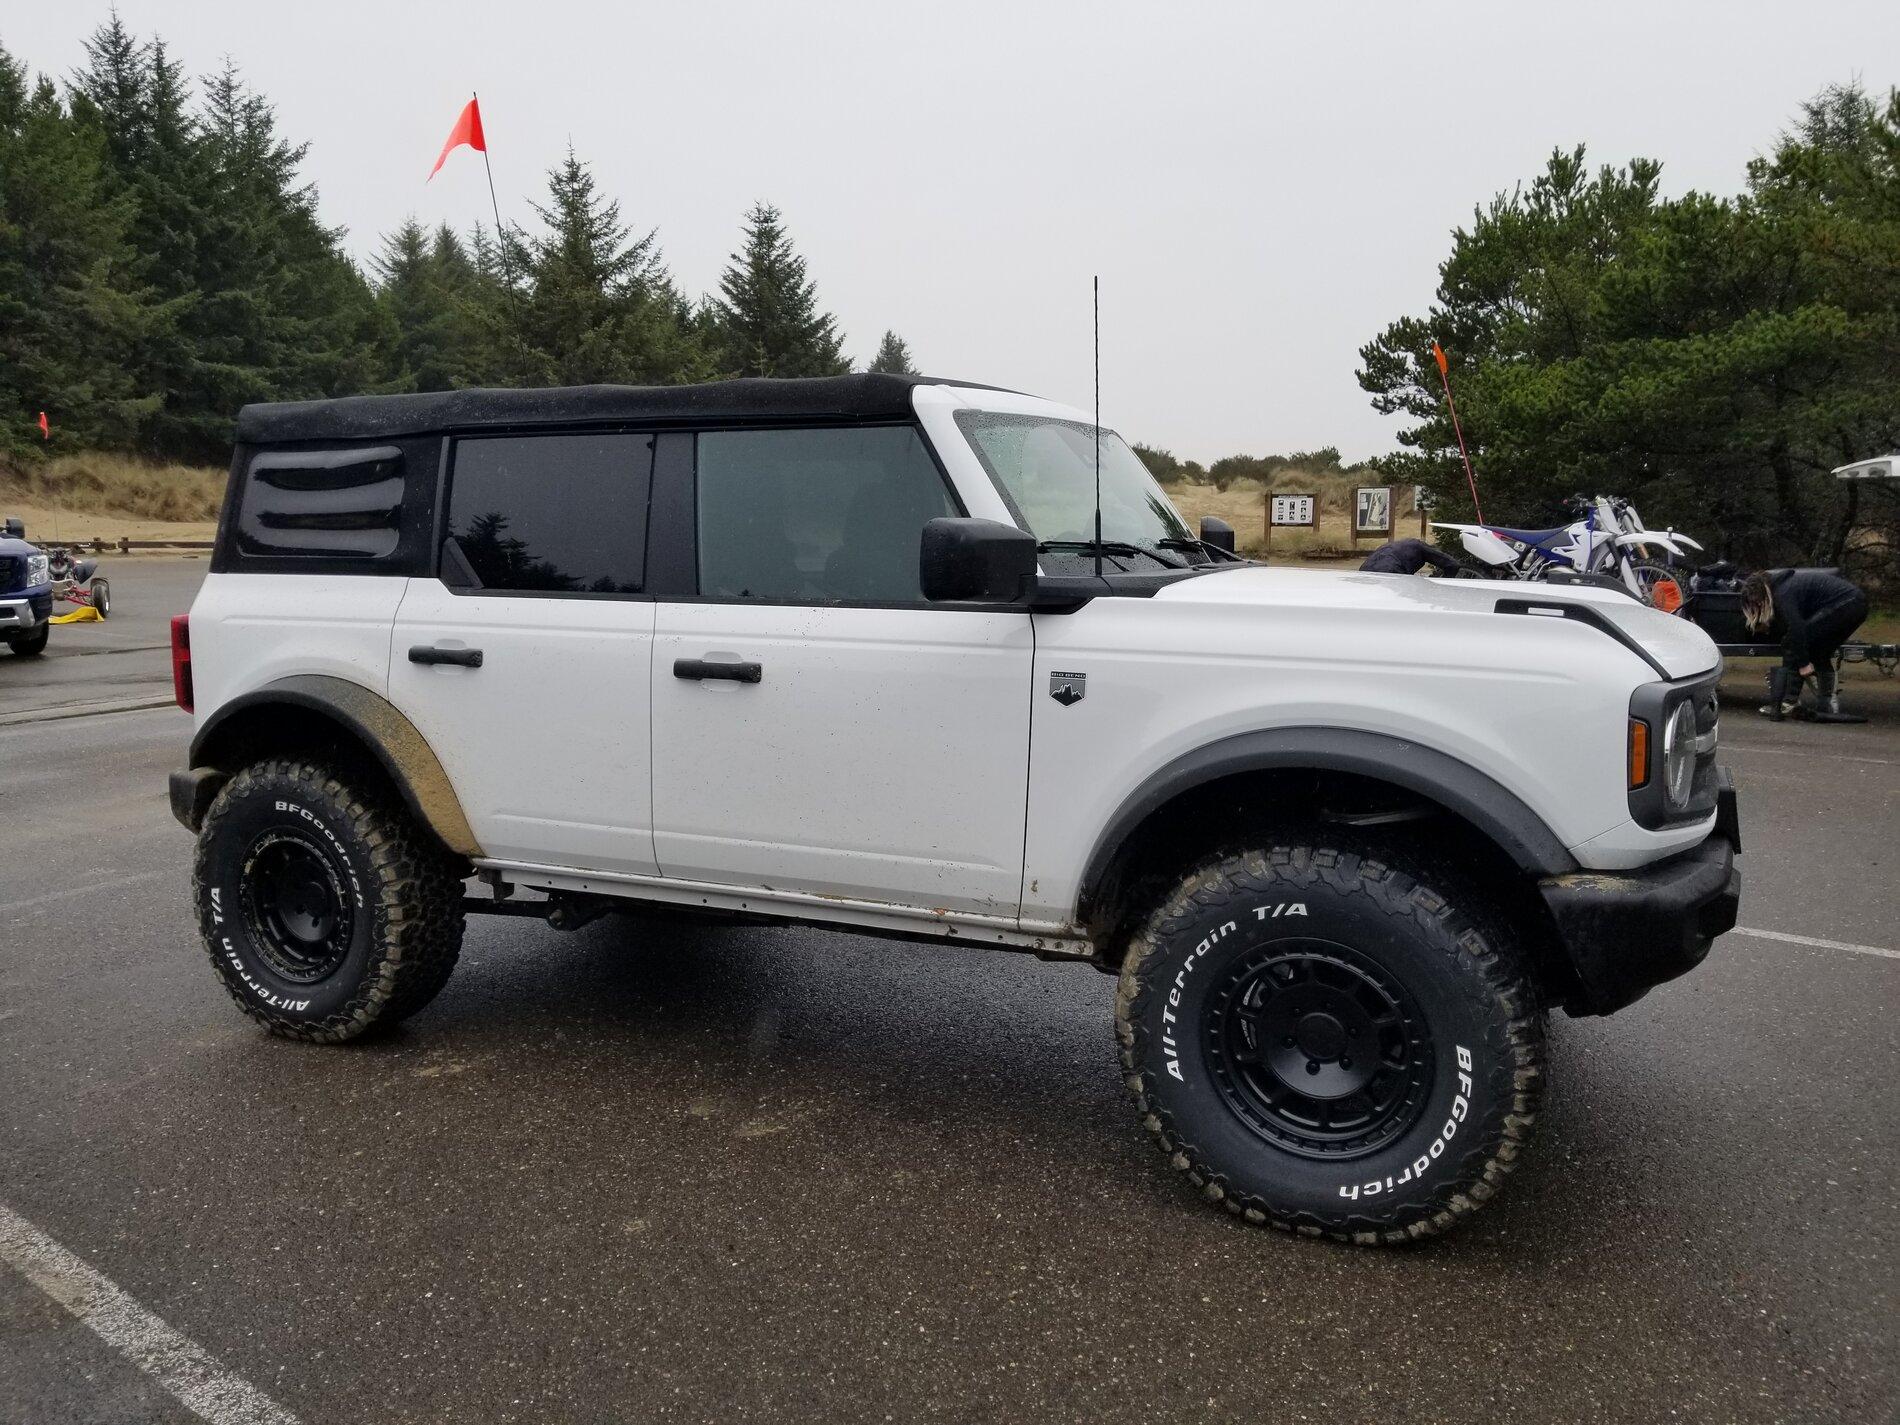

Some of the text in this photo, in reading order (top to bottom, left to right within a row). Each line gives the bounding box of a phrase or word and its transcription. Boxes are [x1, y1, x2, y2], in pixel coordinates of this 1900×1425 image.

[275, 801, 363, 908] BFGoodrich
[211, 887, 310, 1011] All-Terrain T/A
[1161, 903, 1308, 1082] All-Terrain T/A
[1339, 1044, 1472, 1200] BFGoodrich
